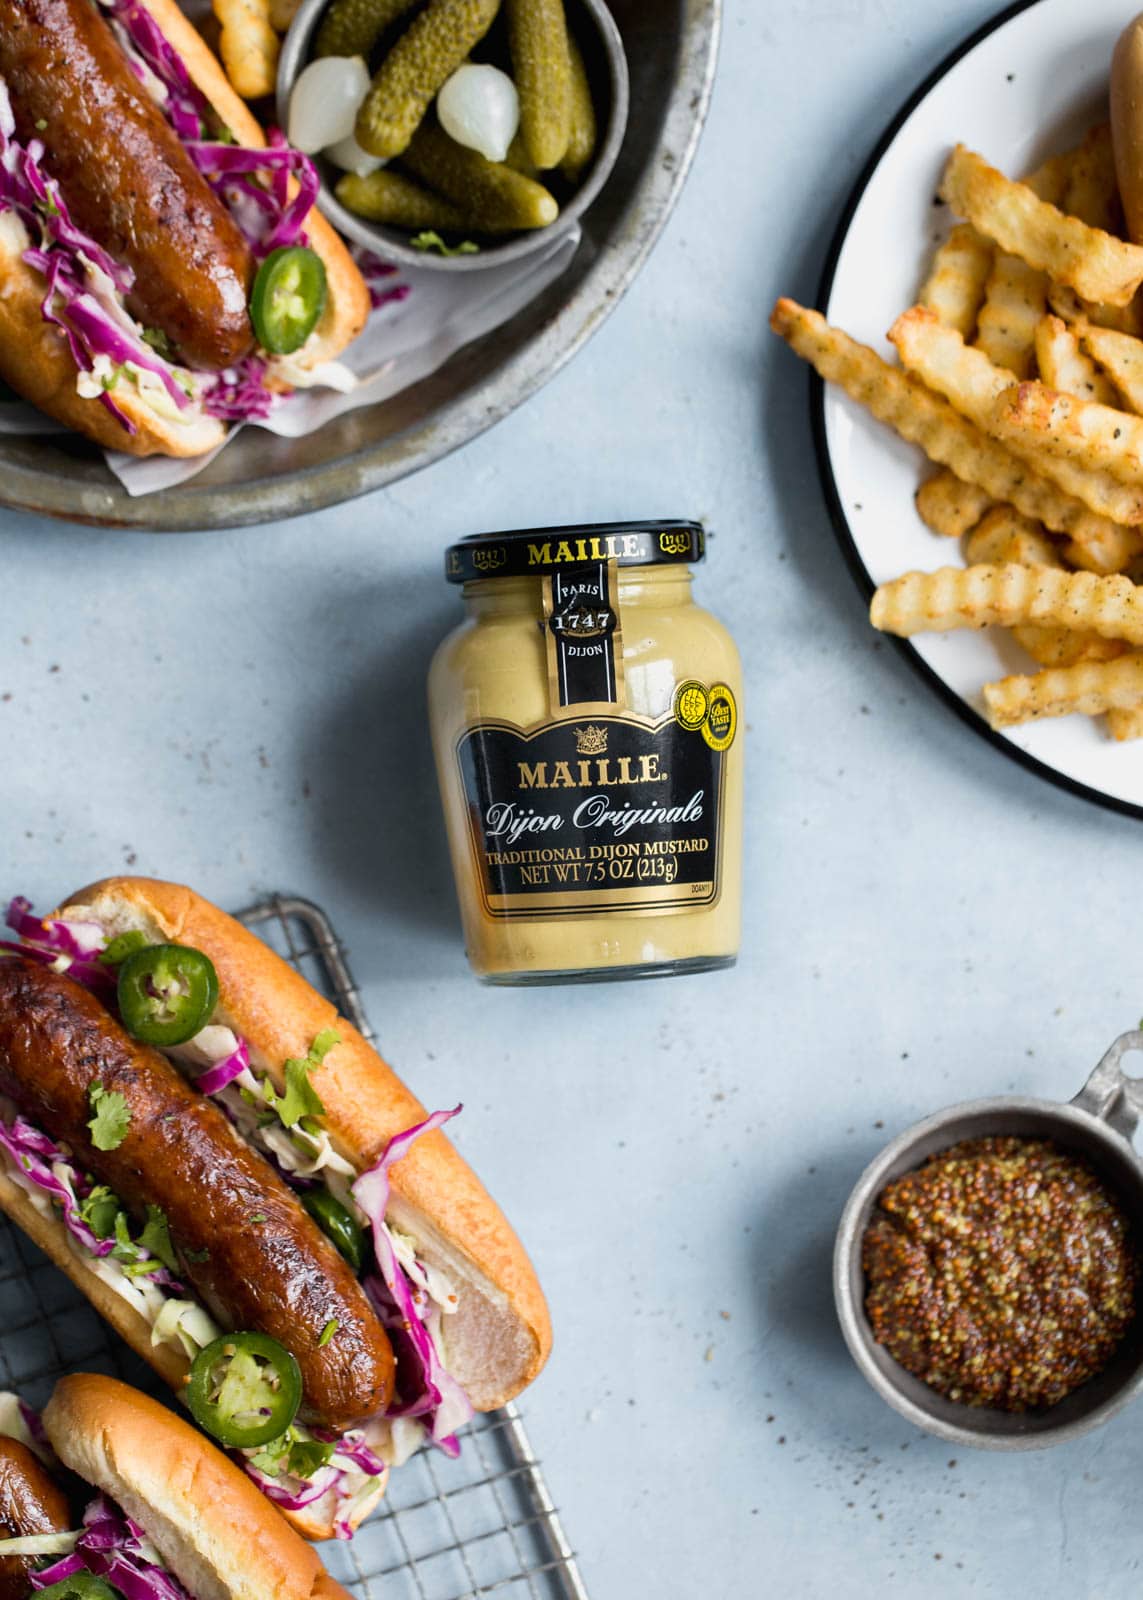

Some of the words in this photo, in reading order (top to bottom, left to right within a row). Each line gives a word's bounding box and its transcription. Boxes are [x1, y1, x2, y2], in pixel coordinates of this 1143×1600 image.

[561, 584, 599, 597] PARIS
[555, 613, 609, 629] 1747
[568, 644, 603, 657] DIJON
[486, 802, 565, 844] Dijon
[573, 790, 704, 836] Originale
[485, 847, 586, 865] TRADITIONAL
[589, 843, 640, 860] DIJON
[644, 838, 709, 855] MUSTARD
[520, 865, 551, 885] NET
[552, 863, 581, 882] WT
[584, 861, 606, 882] 7.5
[609, 859, 634, 879] OZ
[637, 855, 678, 883] (213g)
